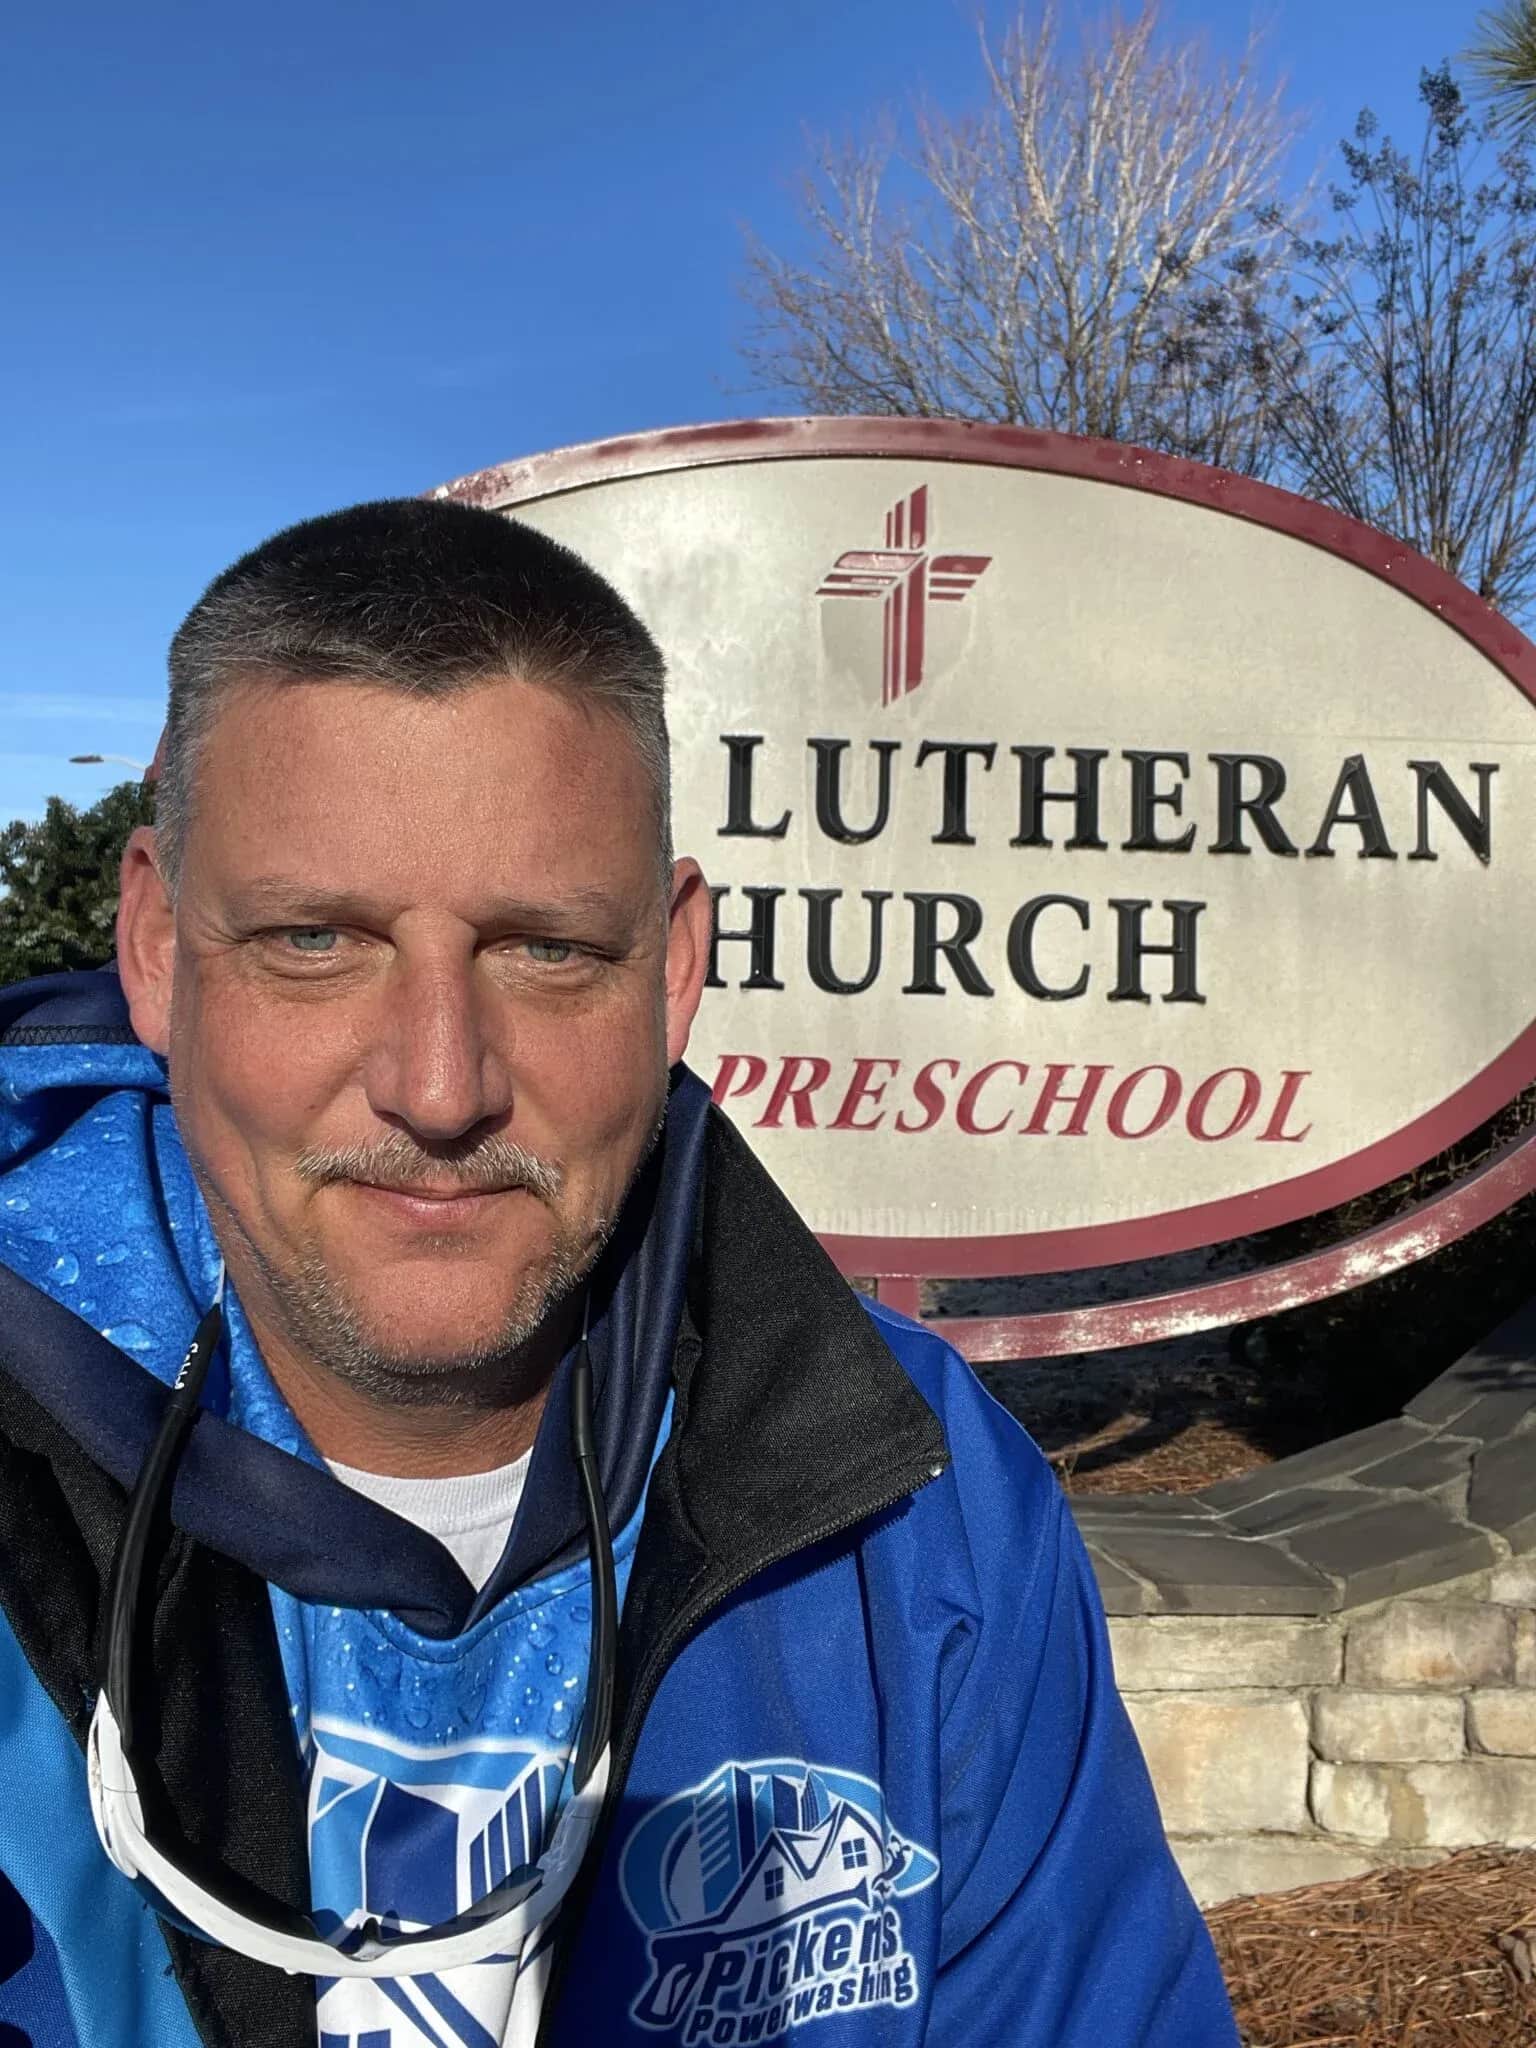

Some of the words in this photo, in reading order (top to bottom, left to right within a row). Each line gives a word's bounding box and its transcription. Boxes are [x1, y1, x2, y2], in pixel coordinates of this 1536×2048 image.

[717, 734, 1500, 867] LUTHERAN
[704, 885, 1207, 1005] HURCH
[711, 1053, 1314, 1143] PRESCHOOL
[685, 1959, 914, 2044] Powerwashing
[701, 1911, 899, 2005] Pickens
